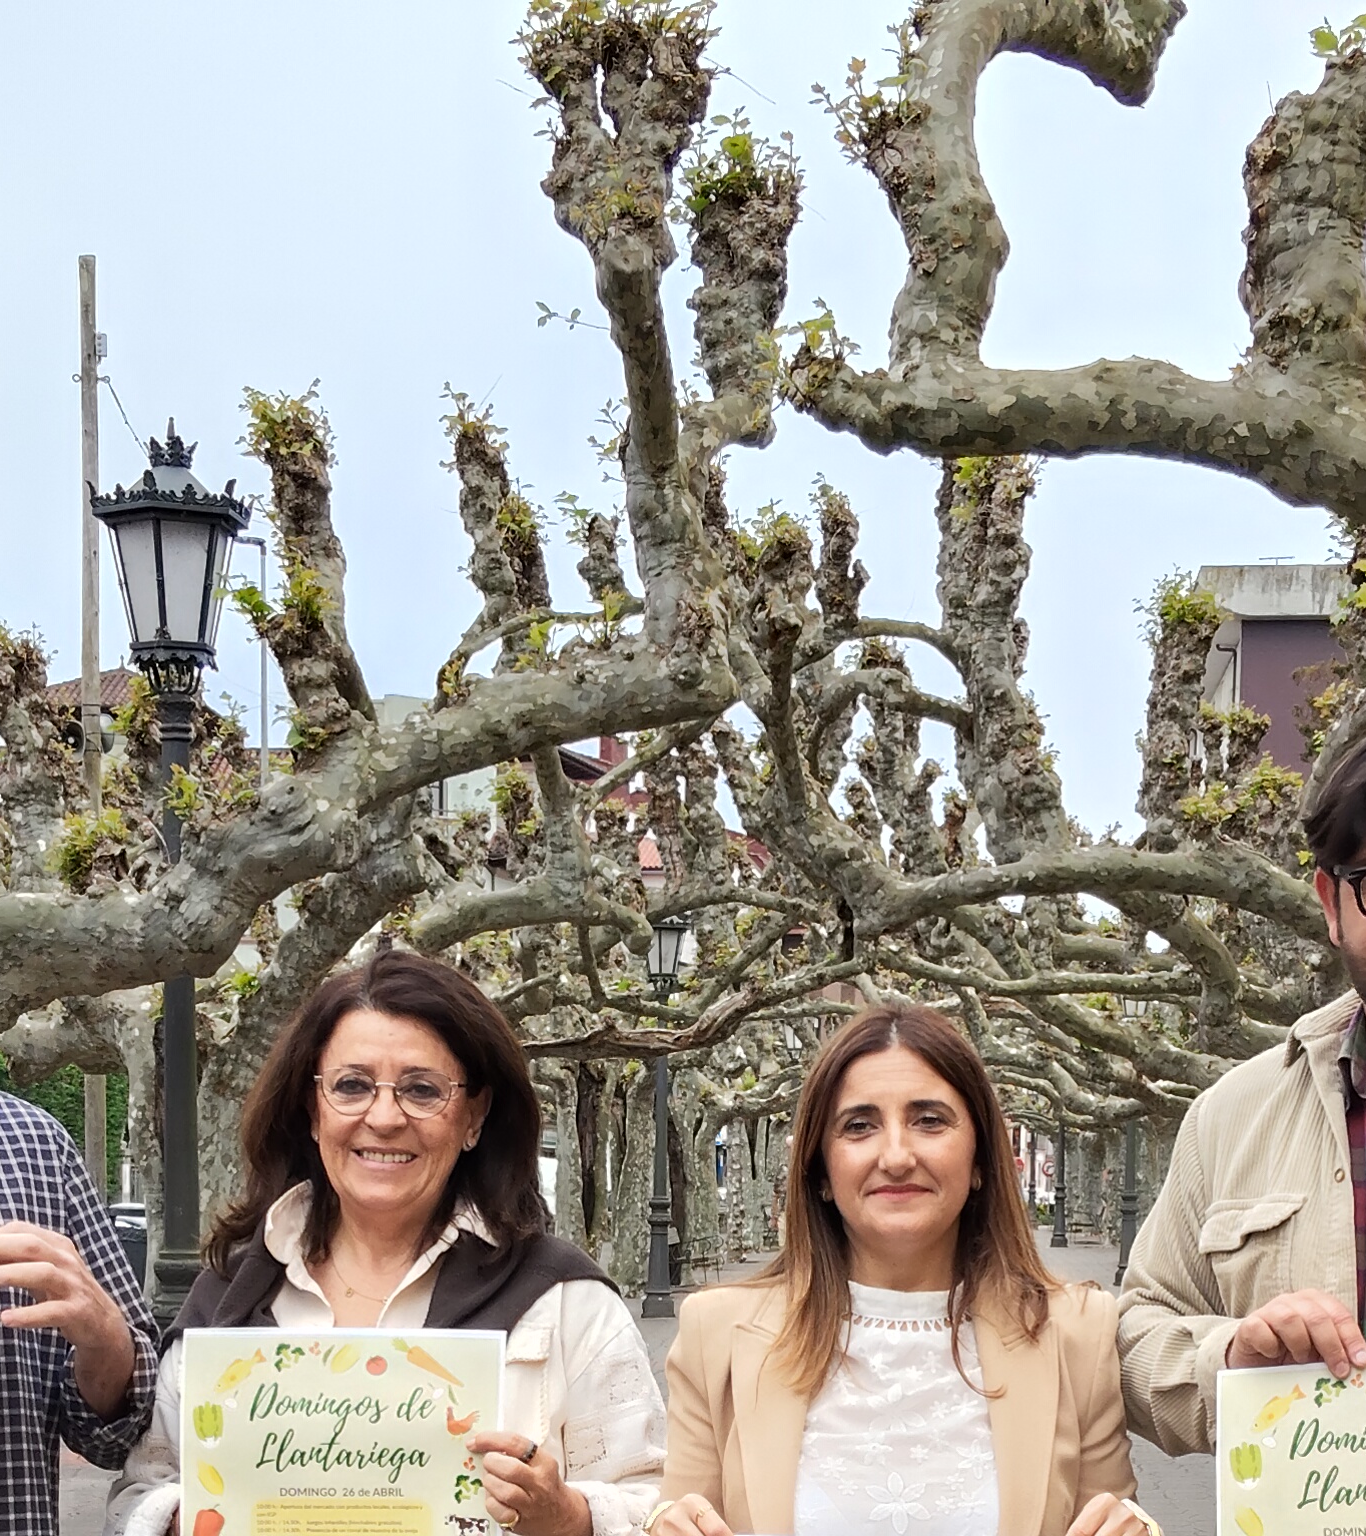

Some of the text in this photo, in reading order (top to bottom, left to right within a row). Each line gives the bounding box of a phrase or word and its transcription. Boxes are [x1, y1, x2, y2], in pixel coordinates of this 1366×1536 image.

[250, 1382, 437, 1434] Domingos de
[256, 1428, 431, 1484] Llantariega
[280, 1487, 404, 1498] DOMINGO 26 de ABRIL
